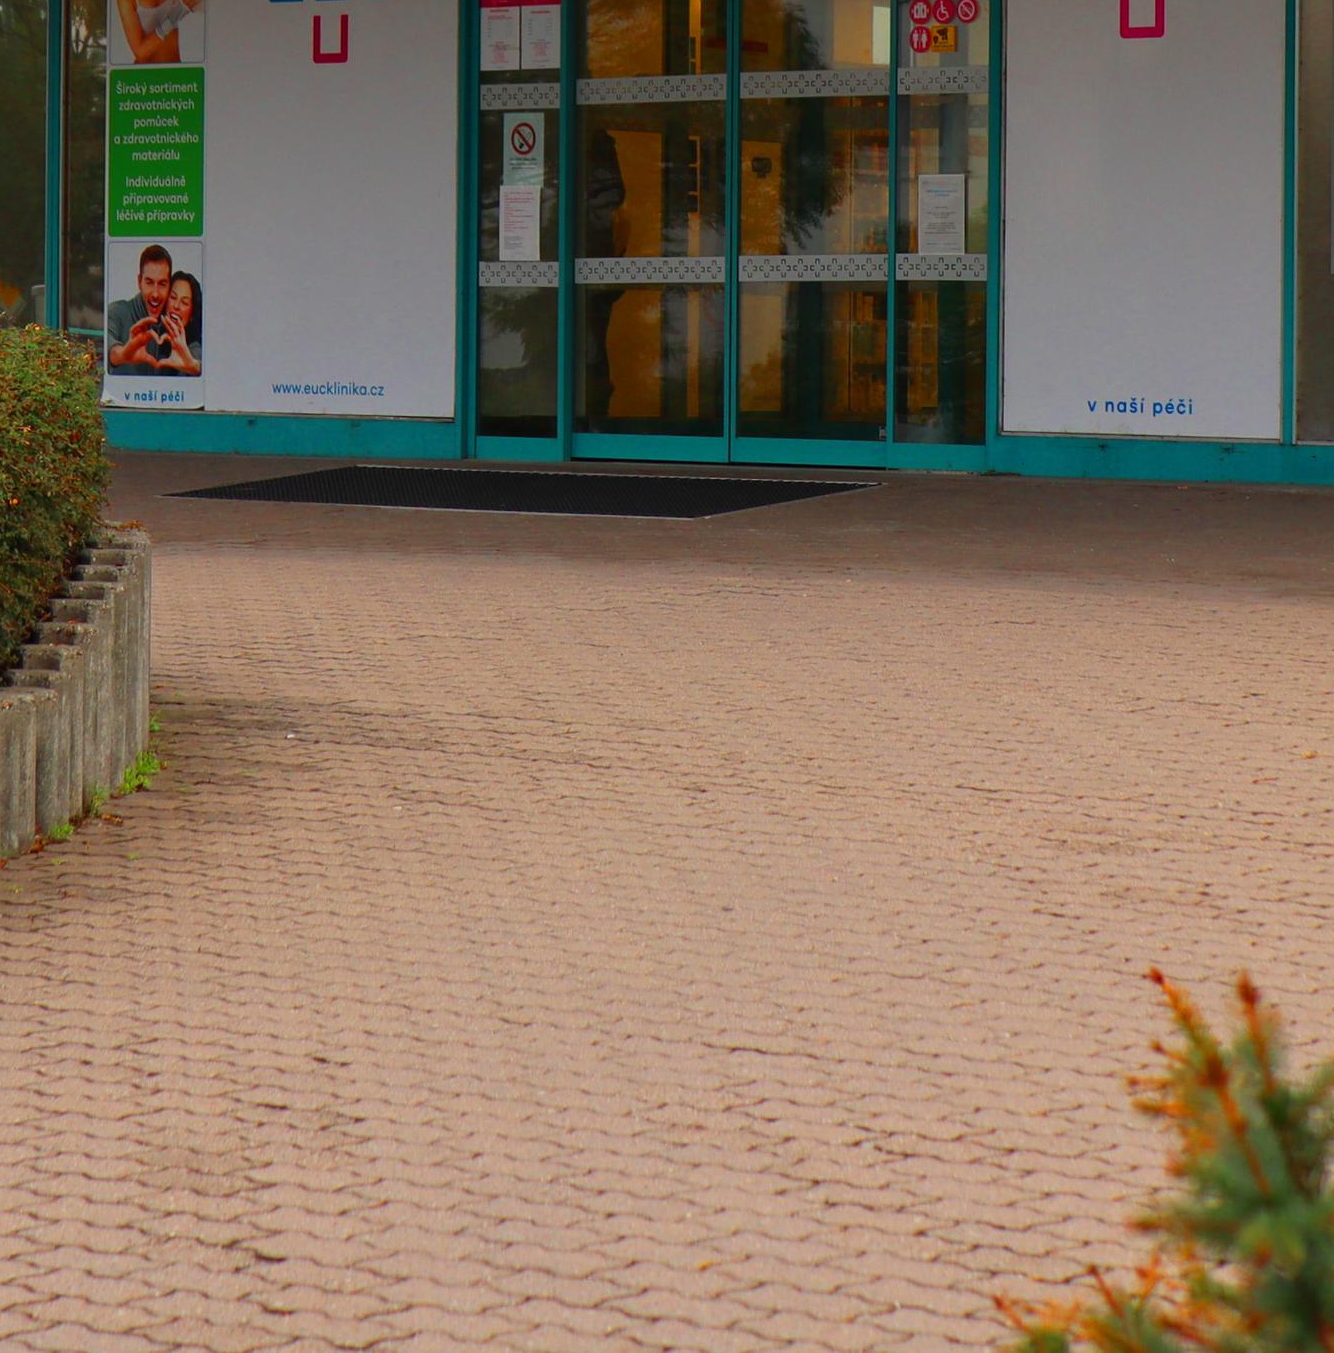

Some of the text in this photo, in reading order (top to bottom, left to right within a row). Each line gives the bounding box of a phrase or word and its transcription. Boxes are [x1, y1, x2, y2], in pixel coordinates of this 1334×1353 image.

[116, 80, 198, 96] Široký sortiment
[118, 98, 195, 111] zdravotnických
[134, 115, 179, 129] pomůcek
[114, 132, 199, 145] a zdravotnického
[132, 150, 180, 161] materiálu
[125, 175, 186, 188] Individuálně
[116, 209, 195, 223] léčivé přípravky
[272, 380, 385, 397] www.eucklinika.cz
[124, 390, 184, 404] v naší péči
[1087, 397, 1193, 417] v naší péči
